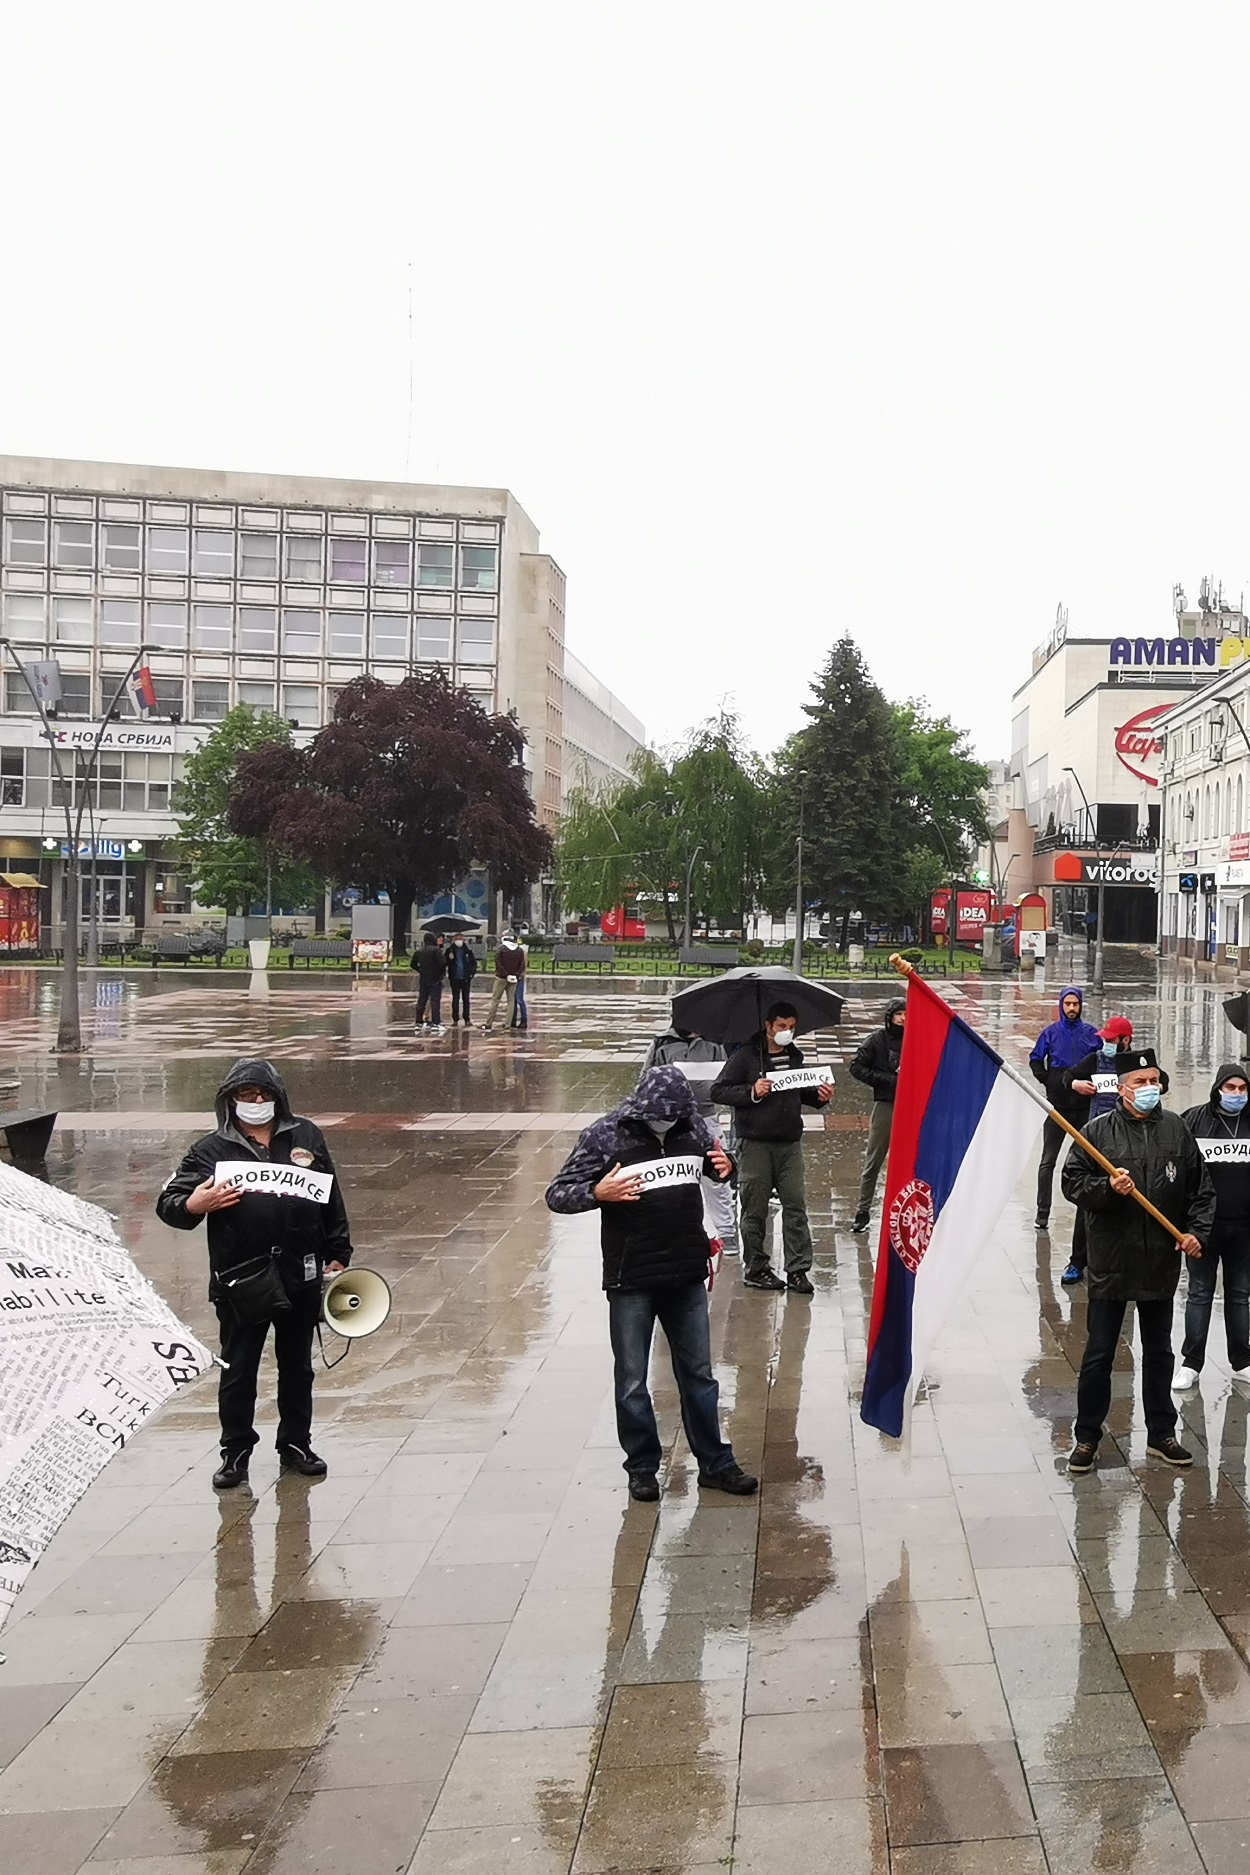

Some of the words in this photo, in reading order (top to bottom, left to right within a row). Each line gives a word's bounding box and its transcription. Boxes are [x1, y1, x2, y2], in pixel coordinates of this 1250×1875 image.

[1110, 637, 1216, 666] AMAN
[117, 733, 172, 745] СРБИЈА
[773, 1073, 816, 1091] ПРОБУДИ
[307, 1183, 324, 1200] СЕ
